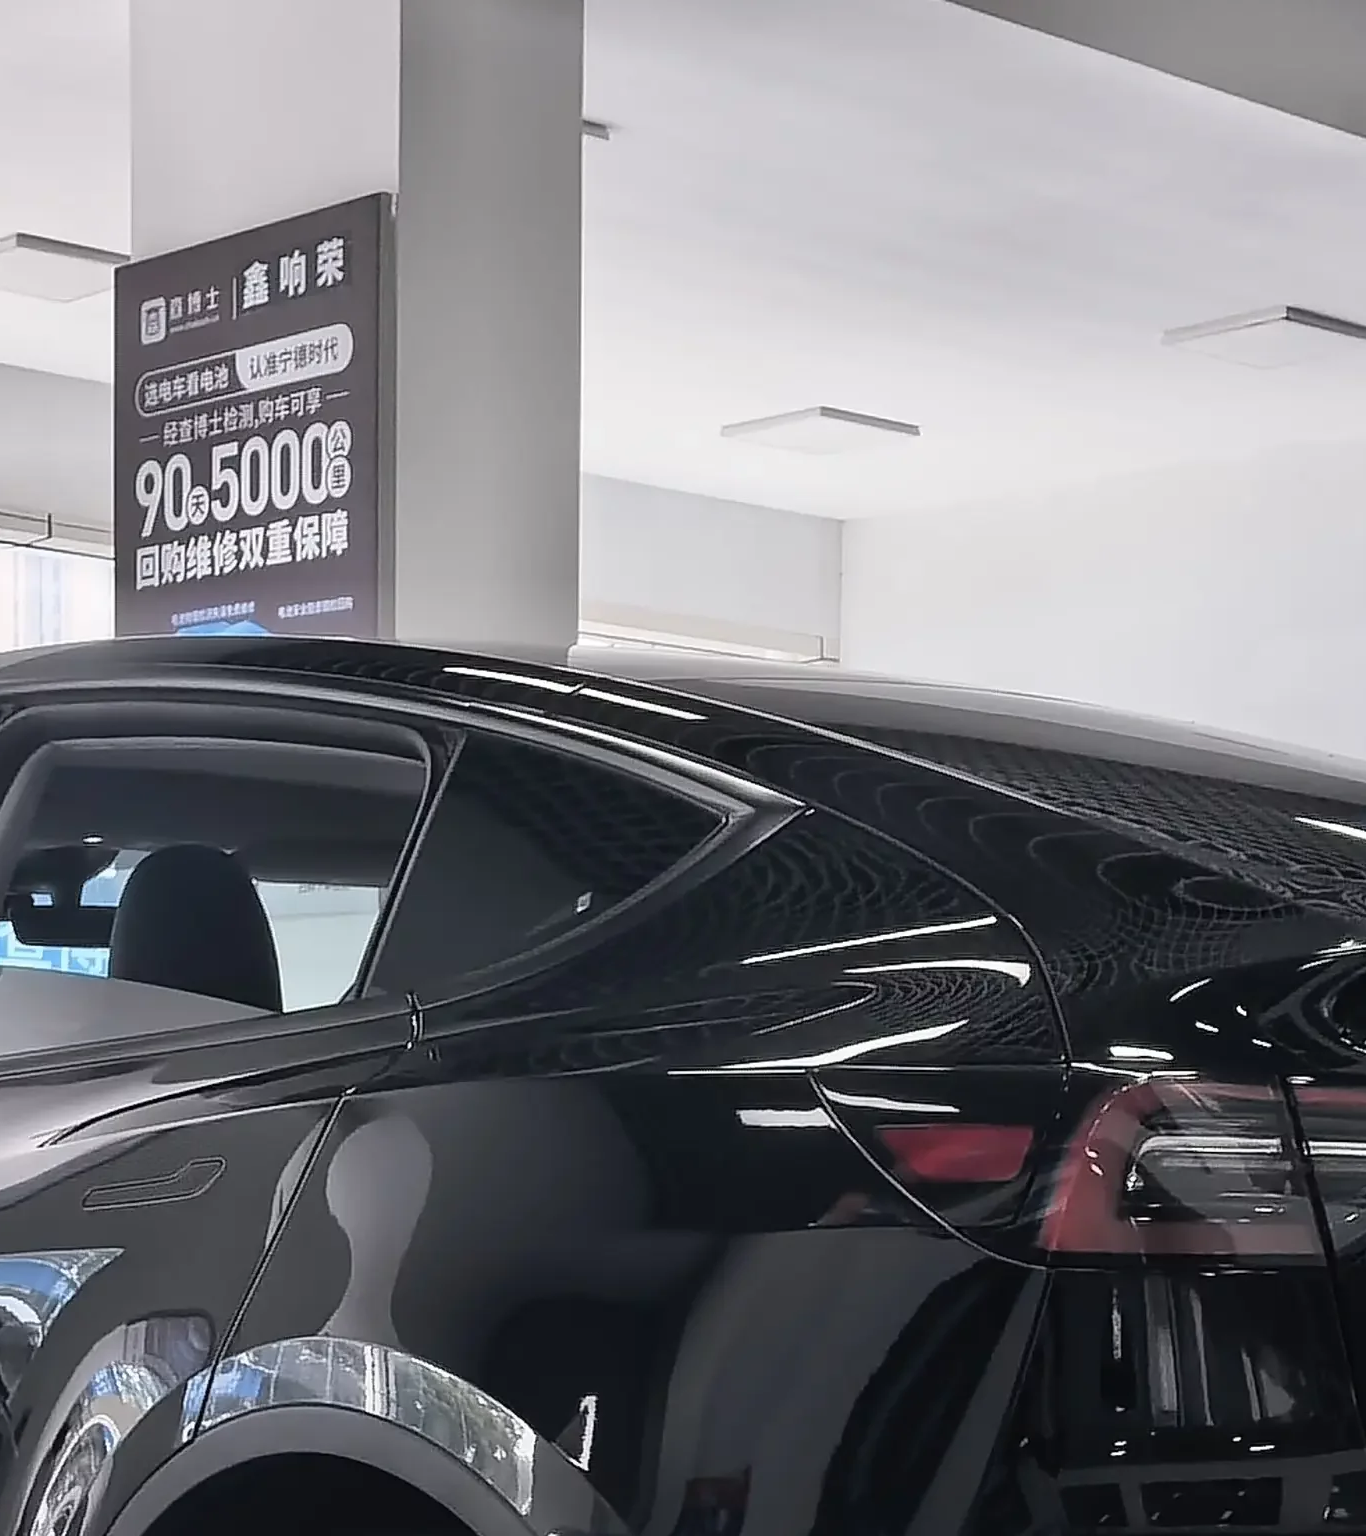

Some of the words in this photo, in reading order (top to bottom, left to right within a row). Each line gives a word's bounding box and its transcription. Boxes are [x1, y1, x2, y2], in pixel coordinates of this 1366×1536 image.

[242, 236, 345, 310] 鑫响荣
[143, 363, 229, 408] 选电车看电池
[248, 336, 339, 381] 认准宁德时代
[136, 508, 349, 590] 回购维修双重保障
